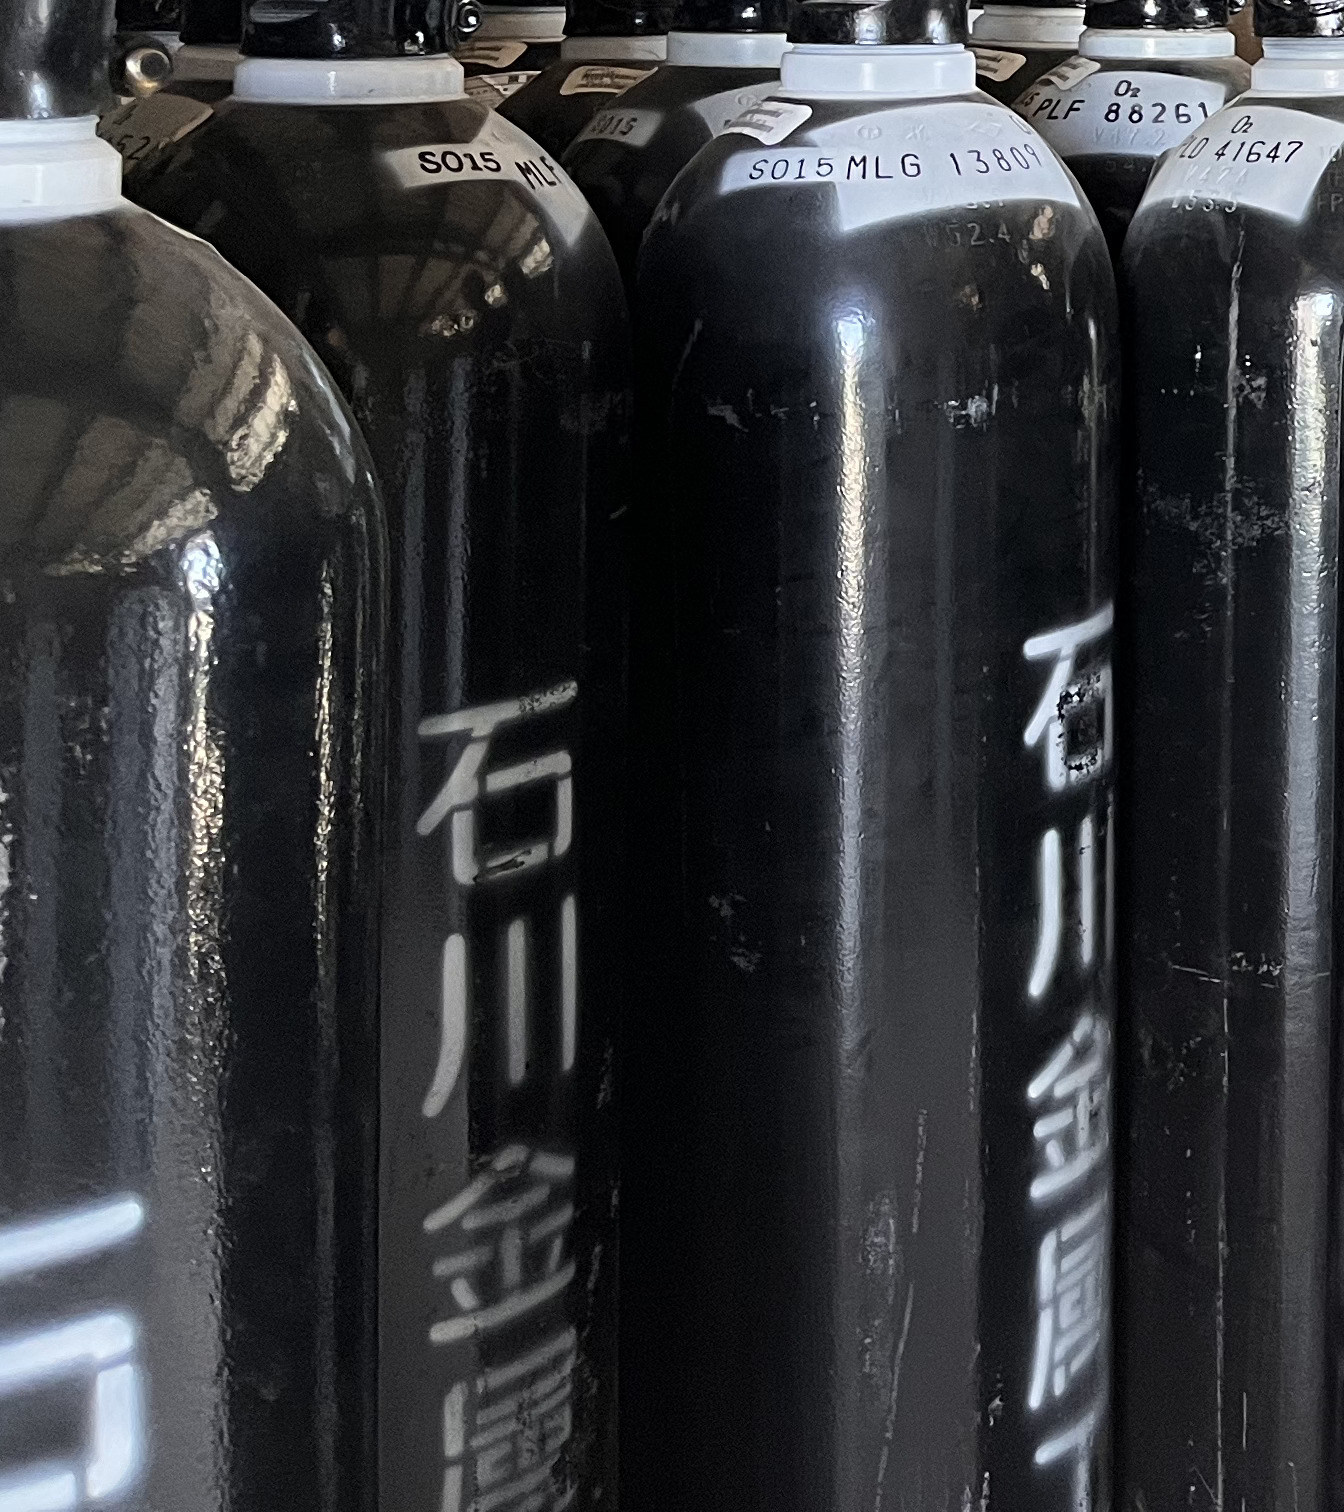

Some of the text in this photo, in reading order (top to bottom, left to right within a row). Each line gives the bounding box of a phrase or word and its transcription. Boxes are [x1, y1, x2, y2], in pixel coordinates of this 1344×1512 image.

[1032, 98, 1209, 124] PLF 88261
[1214, 139, 1304, 164] 41647
